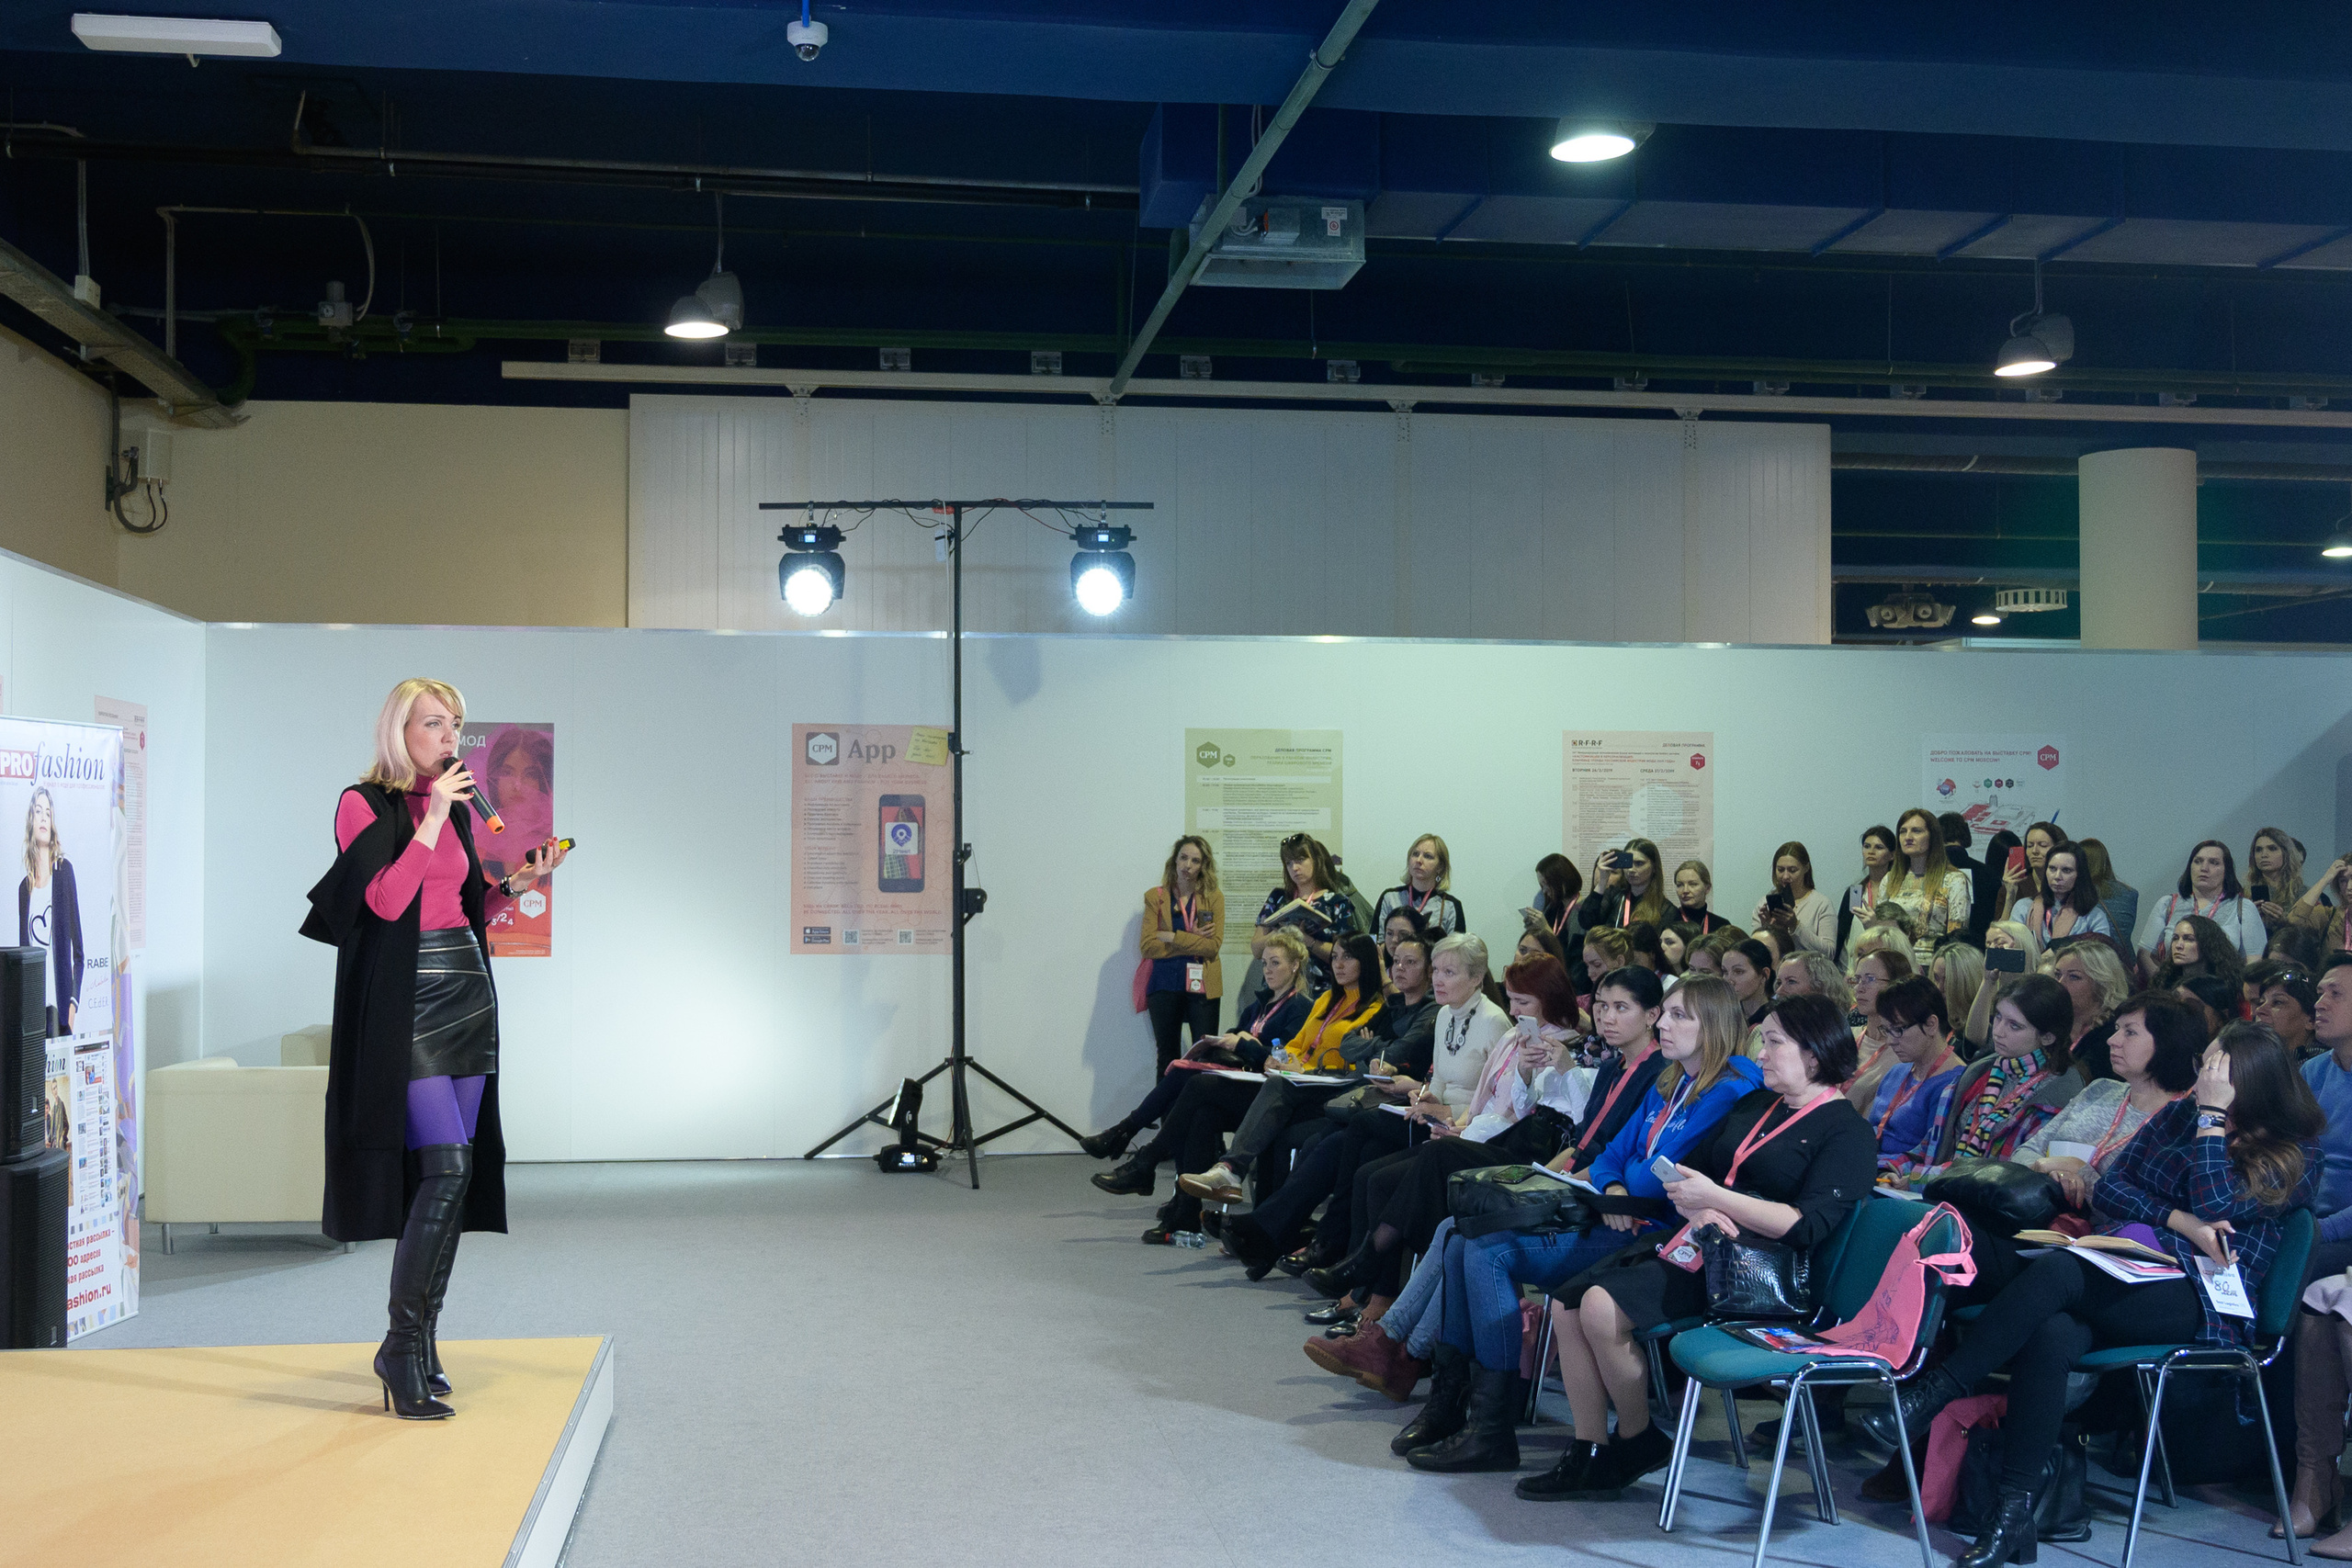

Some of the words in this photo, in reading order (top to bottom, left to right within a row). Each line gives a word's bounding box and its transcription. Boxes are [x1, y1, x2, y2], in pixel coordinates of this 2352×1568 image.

[812, 745, 832, 753] CPM
[848, 739, 896, 763] App
[1199, 750, 1217, 759] CPM
[0, 751, 34, 777] PRO
[30, 740, 105, 786] fashion
[2040, 753, 2057, 761] CPM
[523, 899, 543, 908] CPM
[87, 957, 108, 969] RABE
[68, 1237, 85, 1250] стная
[86, 1229, 110, 1247] рассылка
[80, 1249, 101, 1264] адресов
[78, 1264, 104, 1283] рассылка
